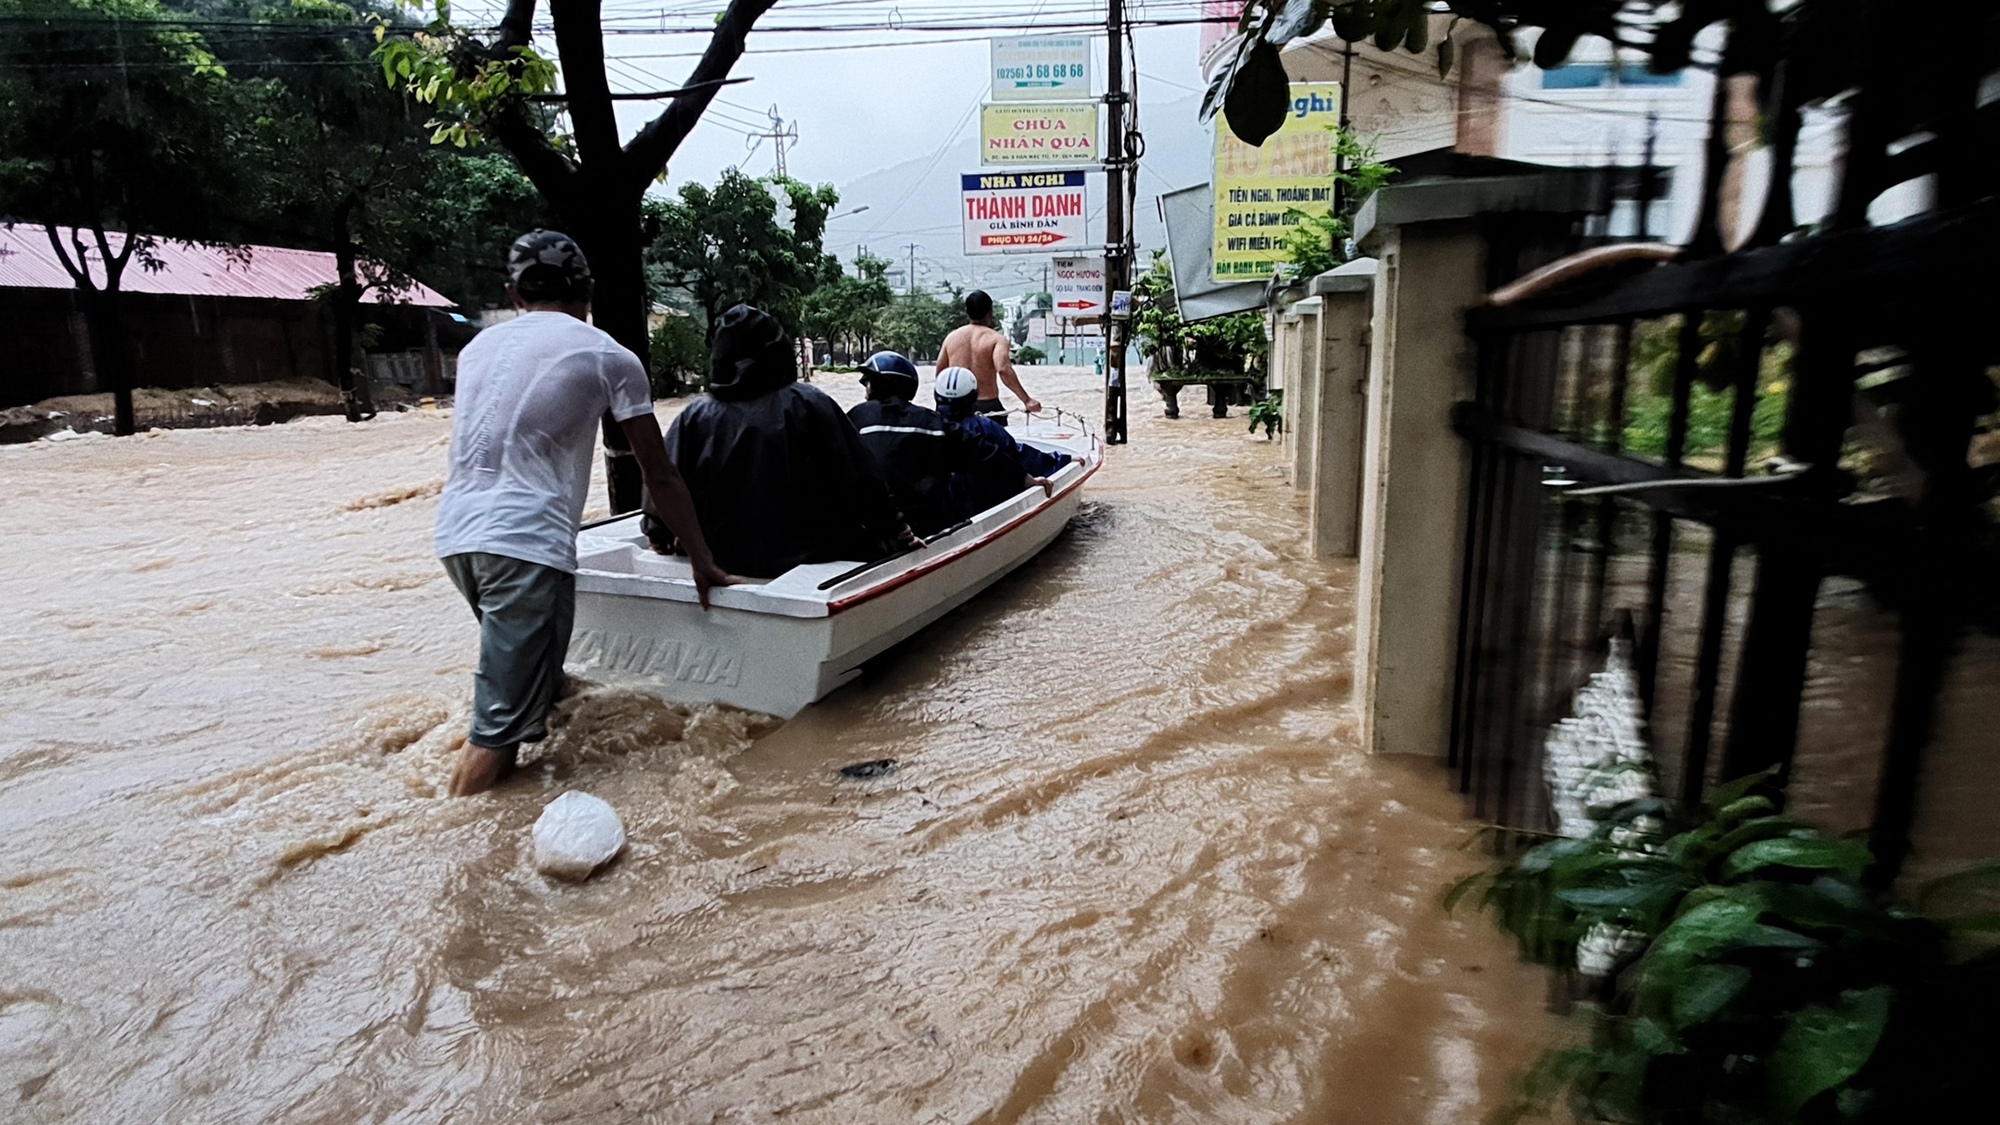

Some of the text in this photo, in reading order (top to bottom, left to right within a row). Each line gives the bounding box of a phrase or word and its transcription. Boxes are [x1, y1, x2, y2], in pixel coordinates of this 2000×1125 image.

[1026, 64, 1033, 79] 3
[1036, 64, 1050, 78] 68
[1053, 64, 1067, 78] 68
[1070, 63, 1083, 78] 68
[1013, 116, 1067, 130] CHÙA
[989, 132, 1091, 150] NHÂN QUẢ
[966, 192, 1082, 220] THÀNH DANH
[989, 218, 1059, 230] GIÁ BÌNH DÂN
[987, 234, 1053, 245] PHỤC VỤ 24/24
[1227, 237, 1247, 251] WIFI
